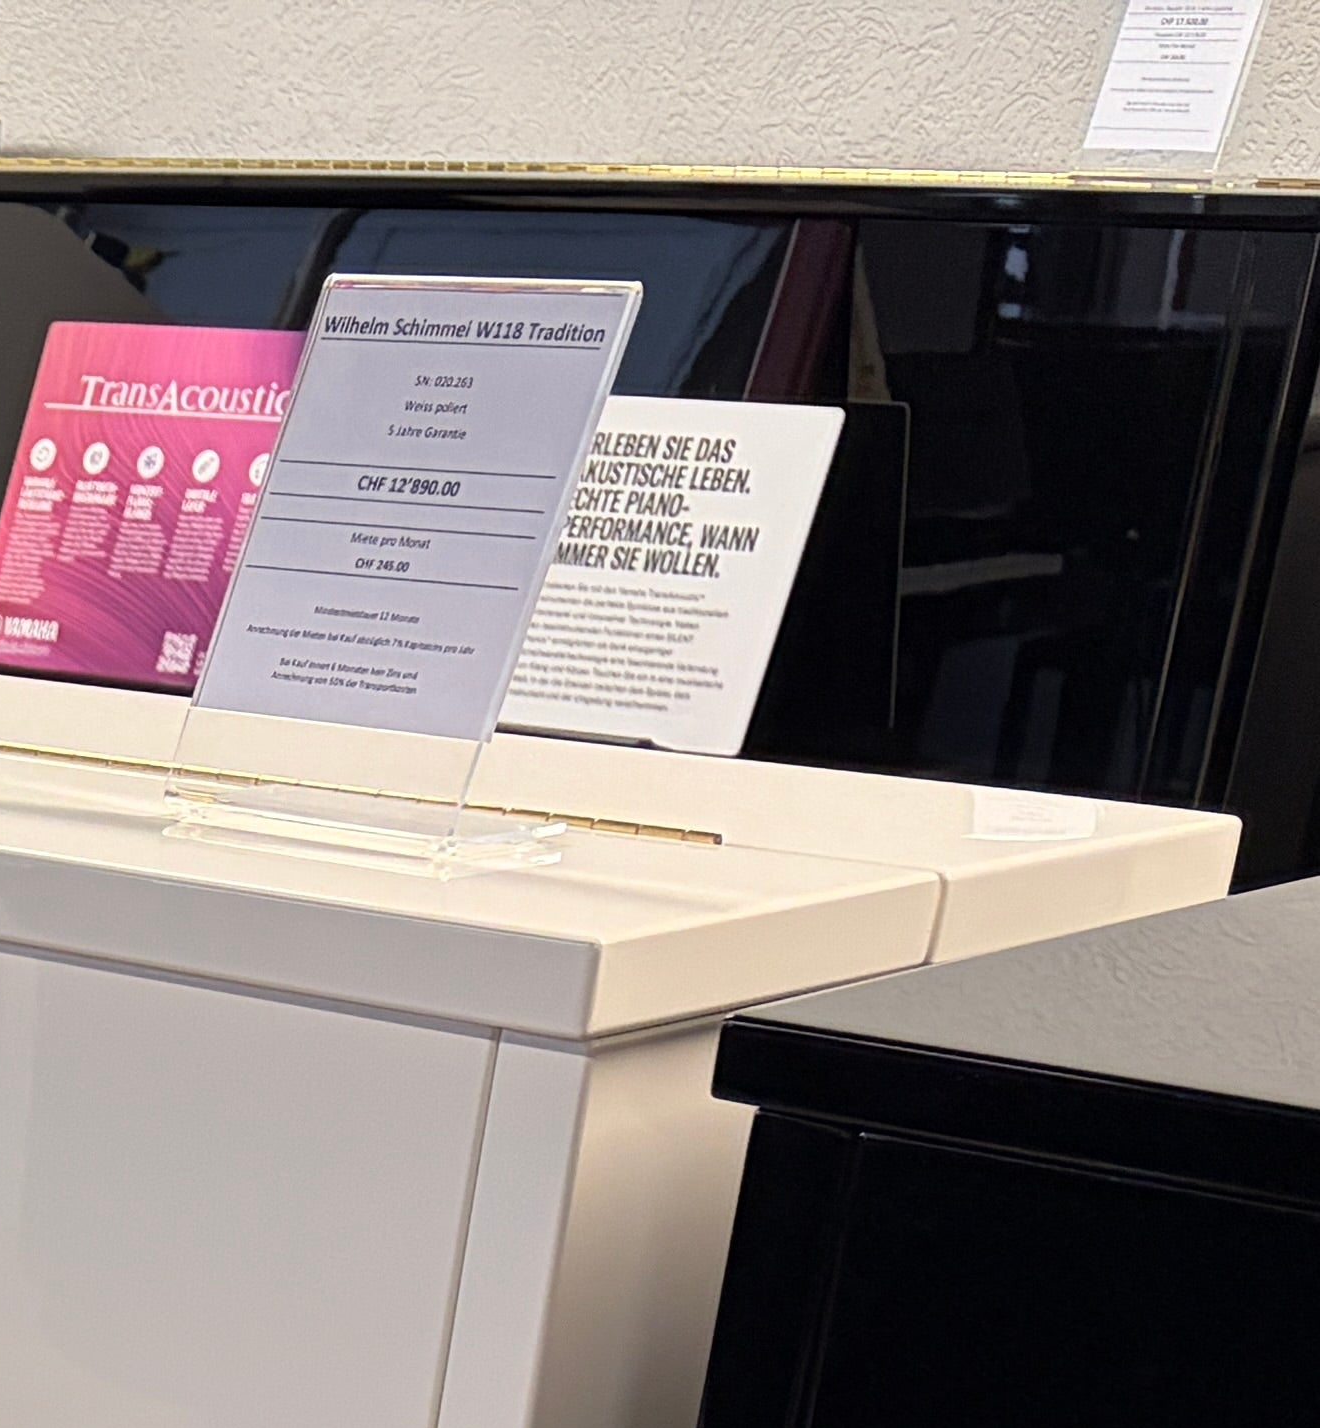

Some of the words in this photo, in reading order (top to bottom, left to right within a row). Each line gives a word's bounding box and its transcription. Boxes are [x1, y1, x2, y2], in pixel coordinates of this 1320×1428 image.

[323, 314, 390, 336] Wilhelm
[392, 317, 473, 338] Schimmel
[476, 320, 524, 340] W118
[528, 322, 606, 344] Tradition
[80, 374, 292, 417] TransAcoustic
[404, 400, 433, 412] Weiss
[434, 401, 468, 414] poliert
[387, 424, 395, 436] 5
[395, 425, 423, 437] Jahre
[424, 426, 467, 440] Garantie
[590, 432, 661, 460] RLEBEN
[662, 435, 694, 462] SIE
[694, 437, 737, 464] DAS
[357, 475, 388, 493] CHF
[580, 460, 688, 490] KUSTISCHE
[688, 466, 751, 495] LEBEN.
[569, 487, 623, 514] CHTE
[624, 489, 691, 518] PIANO-
[350, 532, 379, 546] Miete
[379, 537, 398, 547] pro
[398, 535, 431, 549] Monat
[699, 523, 760, 553] WANN
[355, 557, 376, 571] CHF
[376, 559, 410, 573] 245.00
[553, 541, 611, 570] MMER
[610, 544, 643, 572] SIE
[642, 546, 721, 579] WOLLEN.
